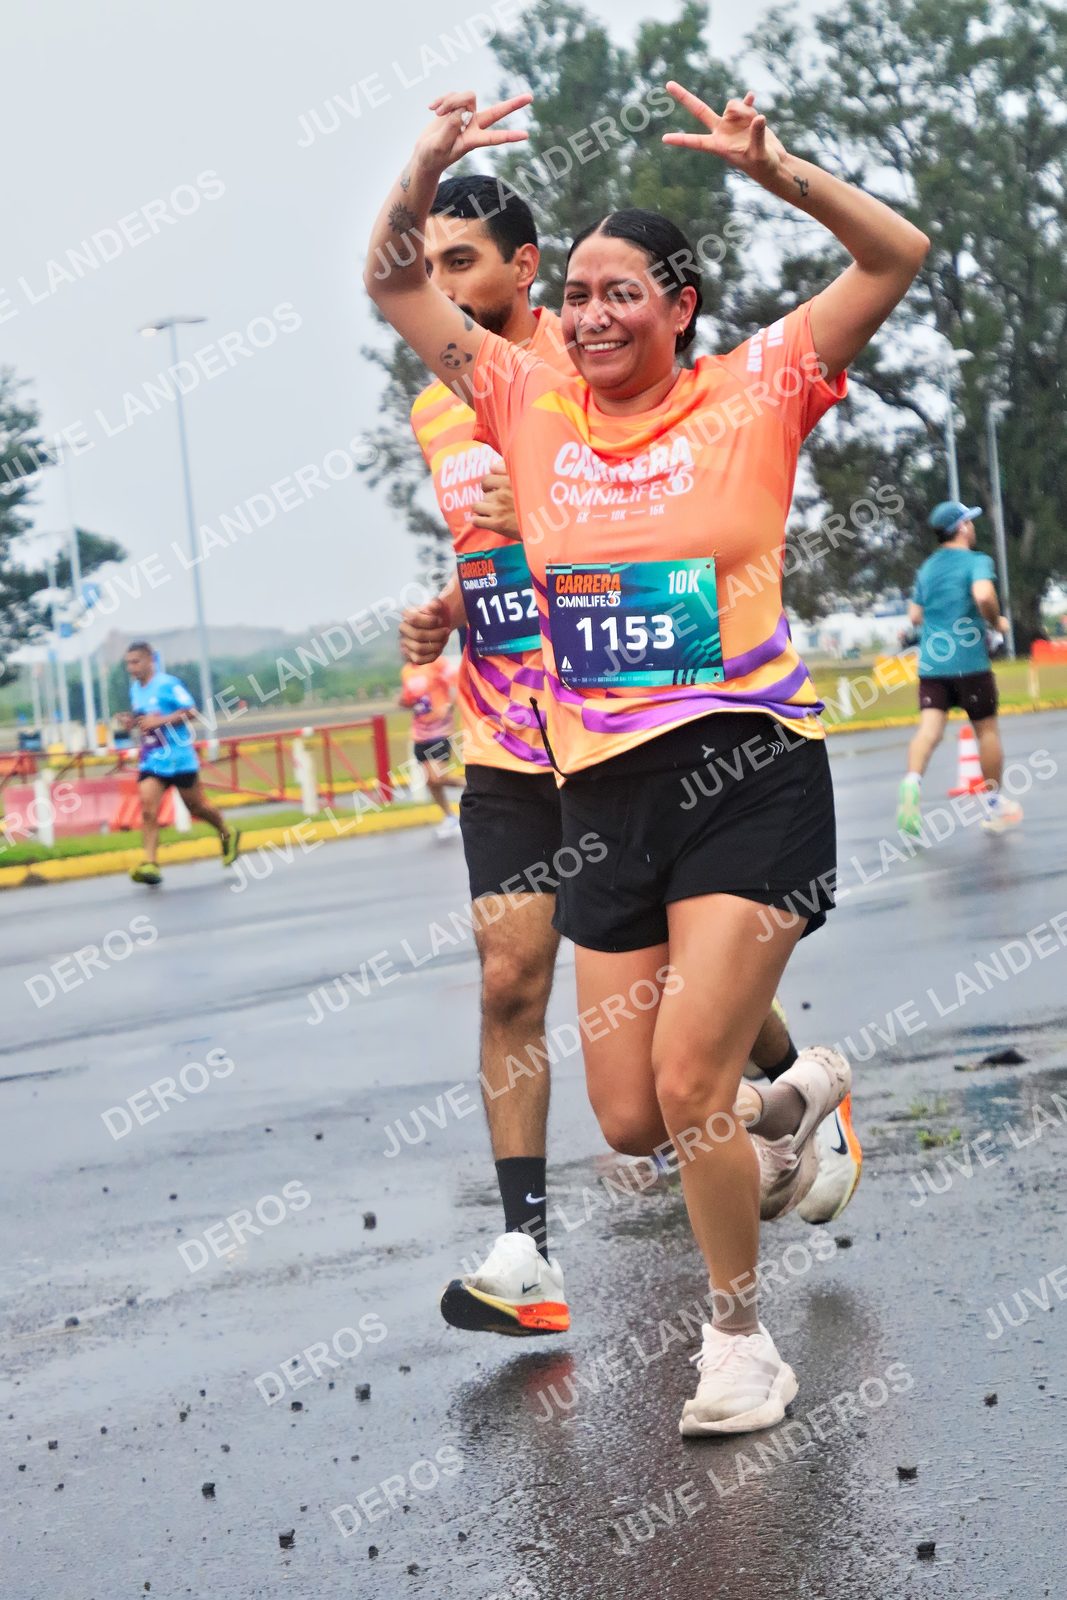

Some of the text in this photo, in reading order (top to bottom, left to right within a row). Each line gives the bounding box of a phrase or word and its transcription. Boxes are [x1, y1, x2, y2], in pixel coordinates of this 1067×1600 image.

[555, 573, 621, 594] CARRERA
[668, 569, 701, 595] 10K
[476, 588, 539, 625] 1152
[576, 614, 675, 651] 1153
